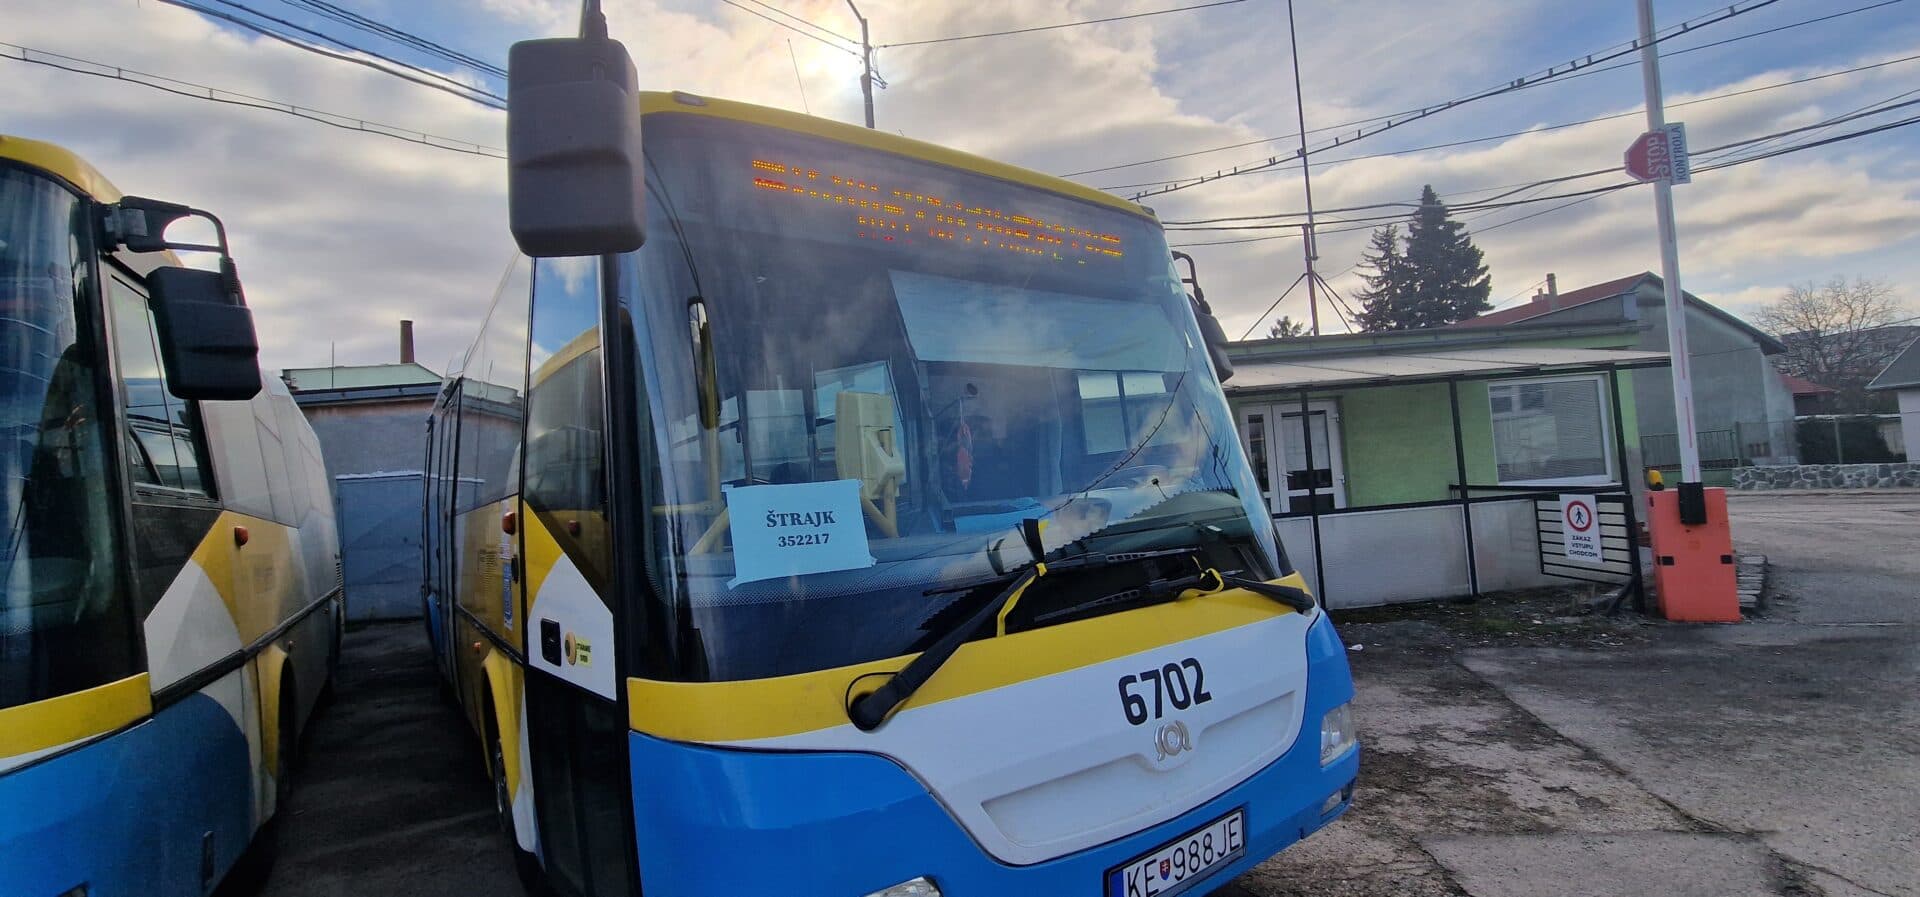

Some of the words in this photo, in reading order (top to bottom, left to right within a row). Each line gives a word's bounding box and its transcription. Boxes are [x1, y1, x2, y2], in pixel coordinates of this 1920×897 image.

[1647, 136, 1670, 175] STOP
[1671, 126, 1687, 180] KONTROLA
[766, 509, 836, 528] ŠTRAJK
[778, 533, 830, 548] 352217
[1118, 657, 1212, 726] 6702
[1127, 859, 1159, 897] KE
[1173, 816, 1241, 882] 988JE
